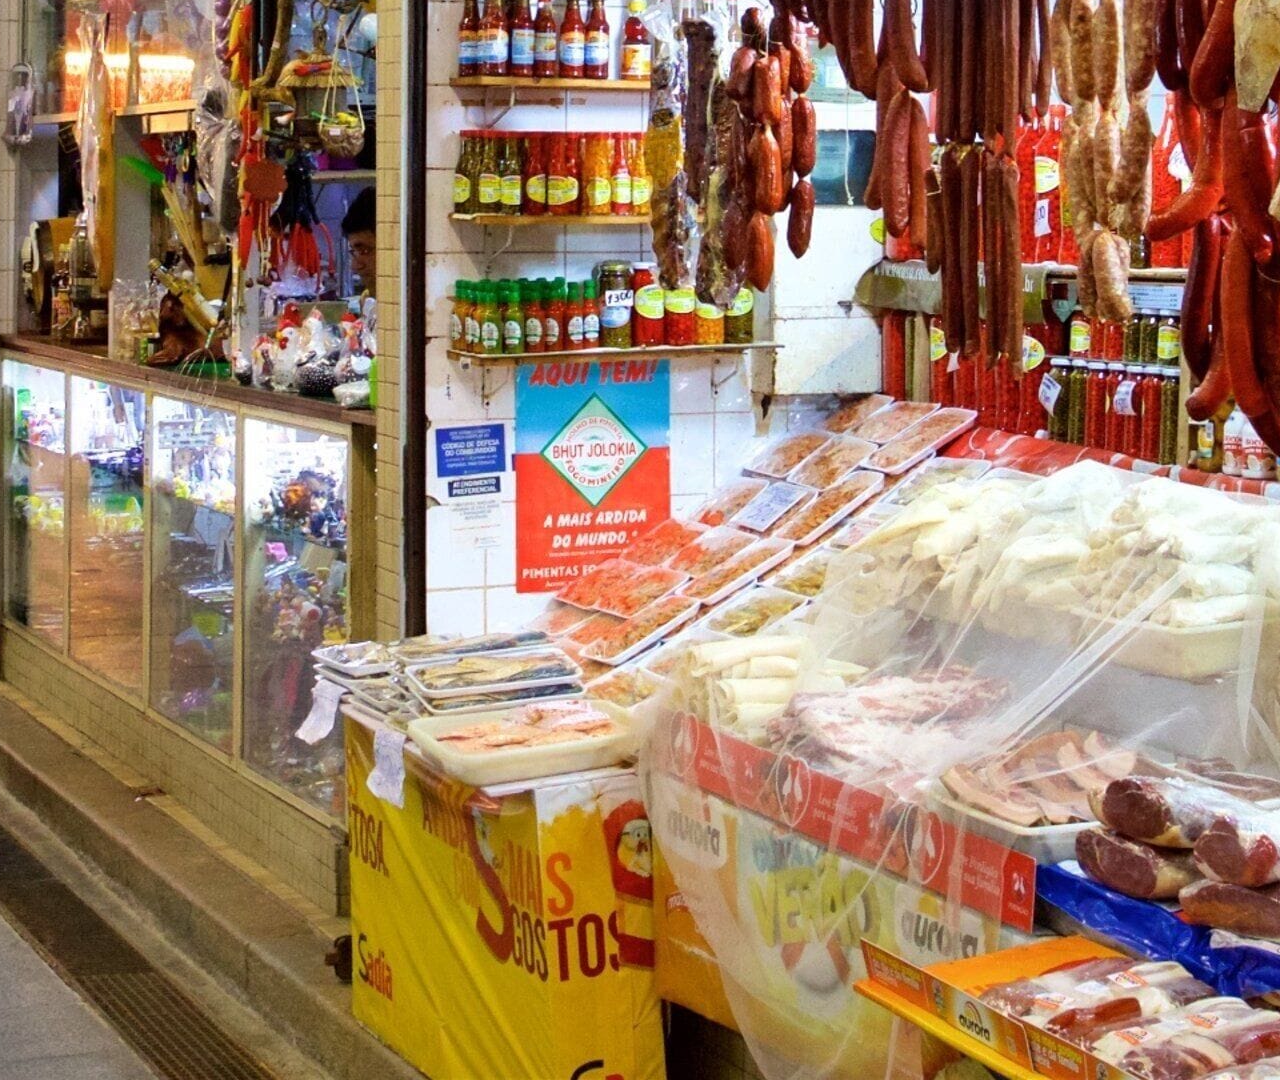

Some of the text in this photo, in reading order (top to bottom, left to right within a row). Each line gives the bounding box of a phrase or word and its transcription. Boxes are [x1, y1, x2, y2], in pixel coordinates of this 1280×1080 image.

[529, 359, 658, 387] AQUI TEM!
[552, 442, 637, 459] BHUT JOLOKIA
[543, 508, 648, 528] A MAIS ARDIDA
[551, 534, 572, 549] DO
[522, 566, 579, 579] PIMENTAS
[959, 1014, 990, 1042] aurora
